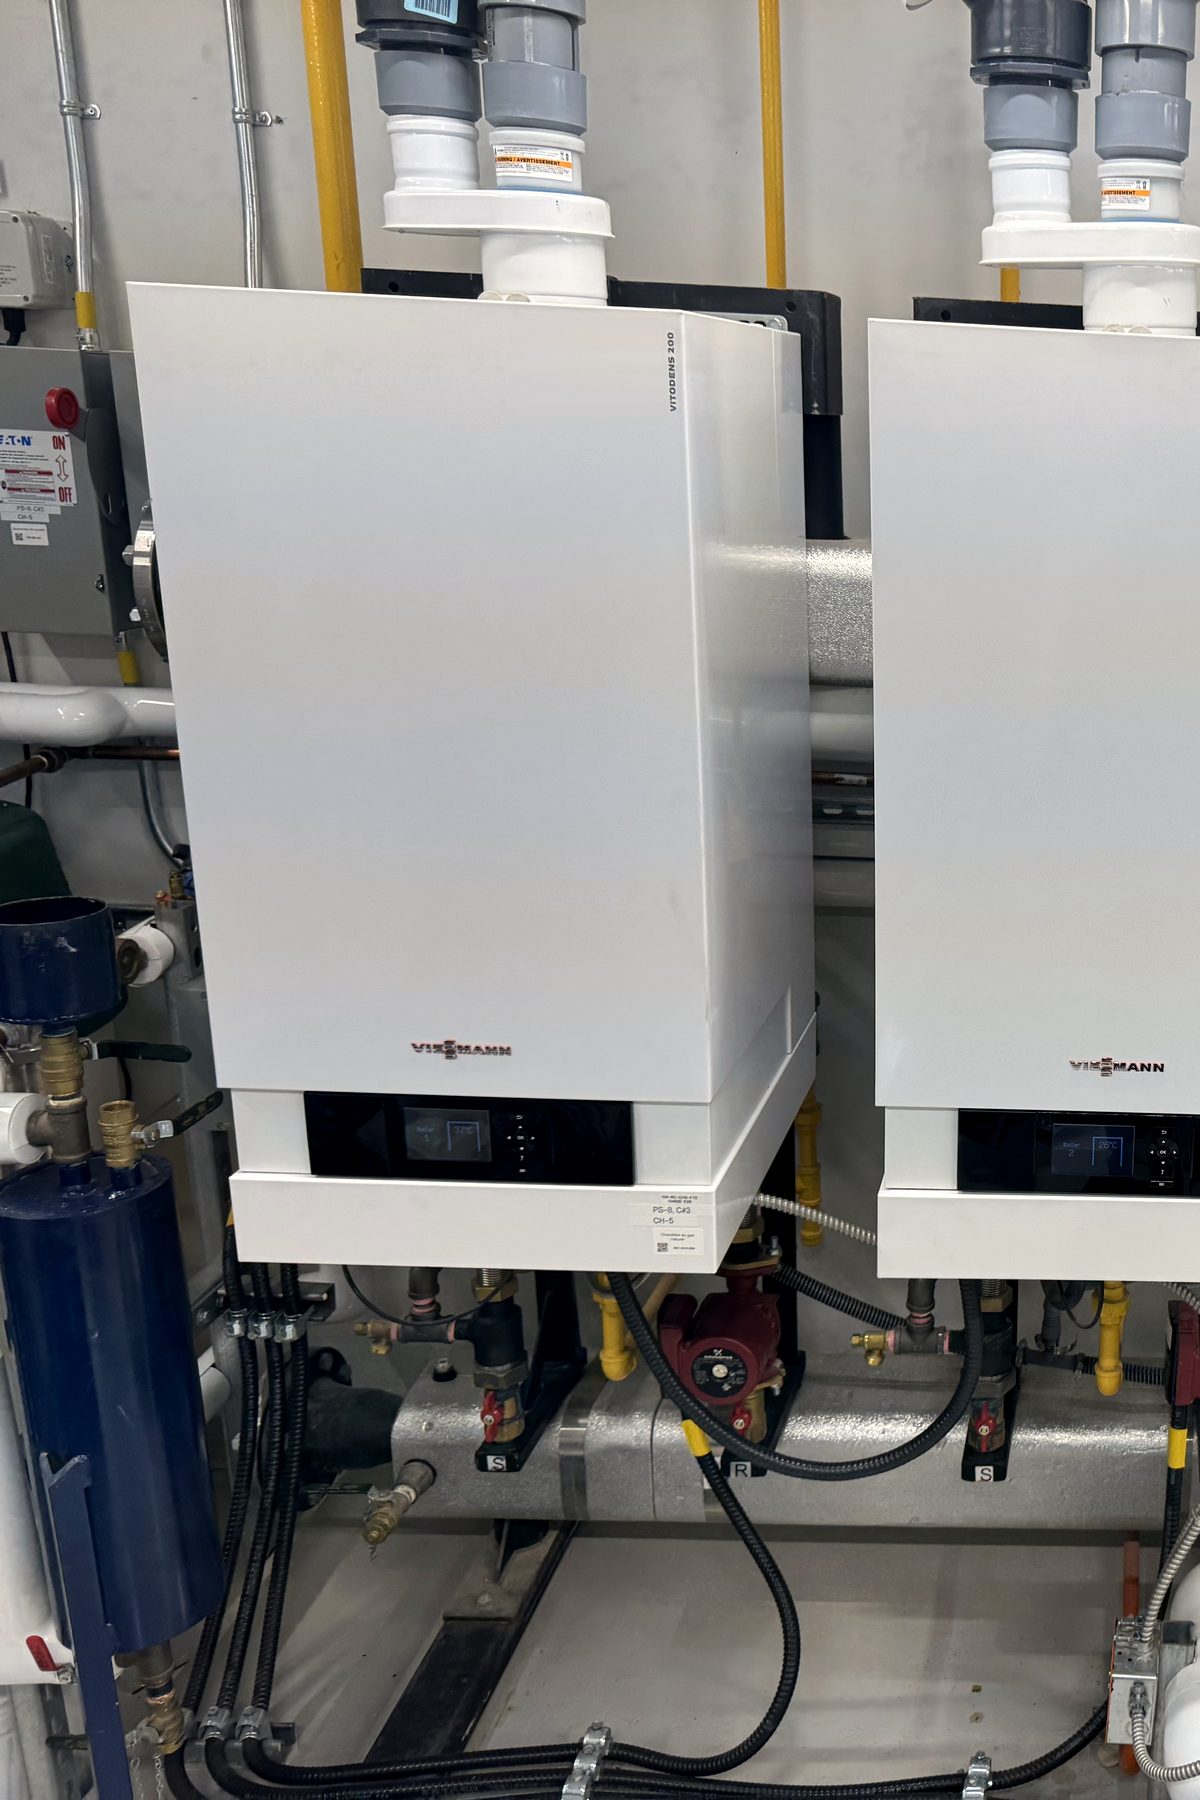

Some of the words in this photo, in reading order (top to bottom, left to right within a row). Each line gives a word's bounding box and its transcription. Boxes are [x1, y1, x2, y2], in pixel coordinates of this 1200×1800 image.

[517, 156, 561, 166] AVERTISSEMENT
[667, 332, 675, 353] 200
[668, 357, 677, 412] VITODENS
[53, 435, 66, 450] ON
[58, 487, 73, 503] OFF
[1069, 1057, 1165, 1077] VIESSMANN
[1068, 1149, 1074, 1157] 2
[652, 1206, 675, 1214] PS-8,
[676, 1206, 691, 1214] C#3
[493, 1456, 505, 1471] S
[735, 1463, 748, 1477] R
[980, 1467, 992, 1481] S
